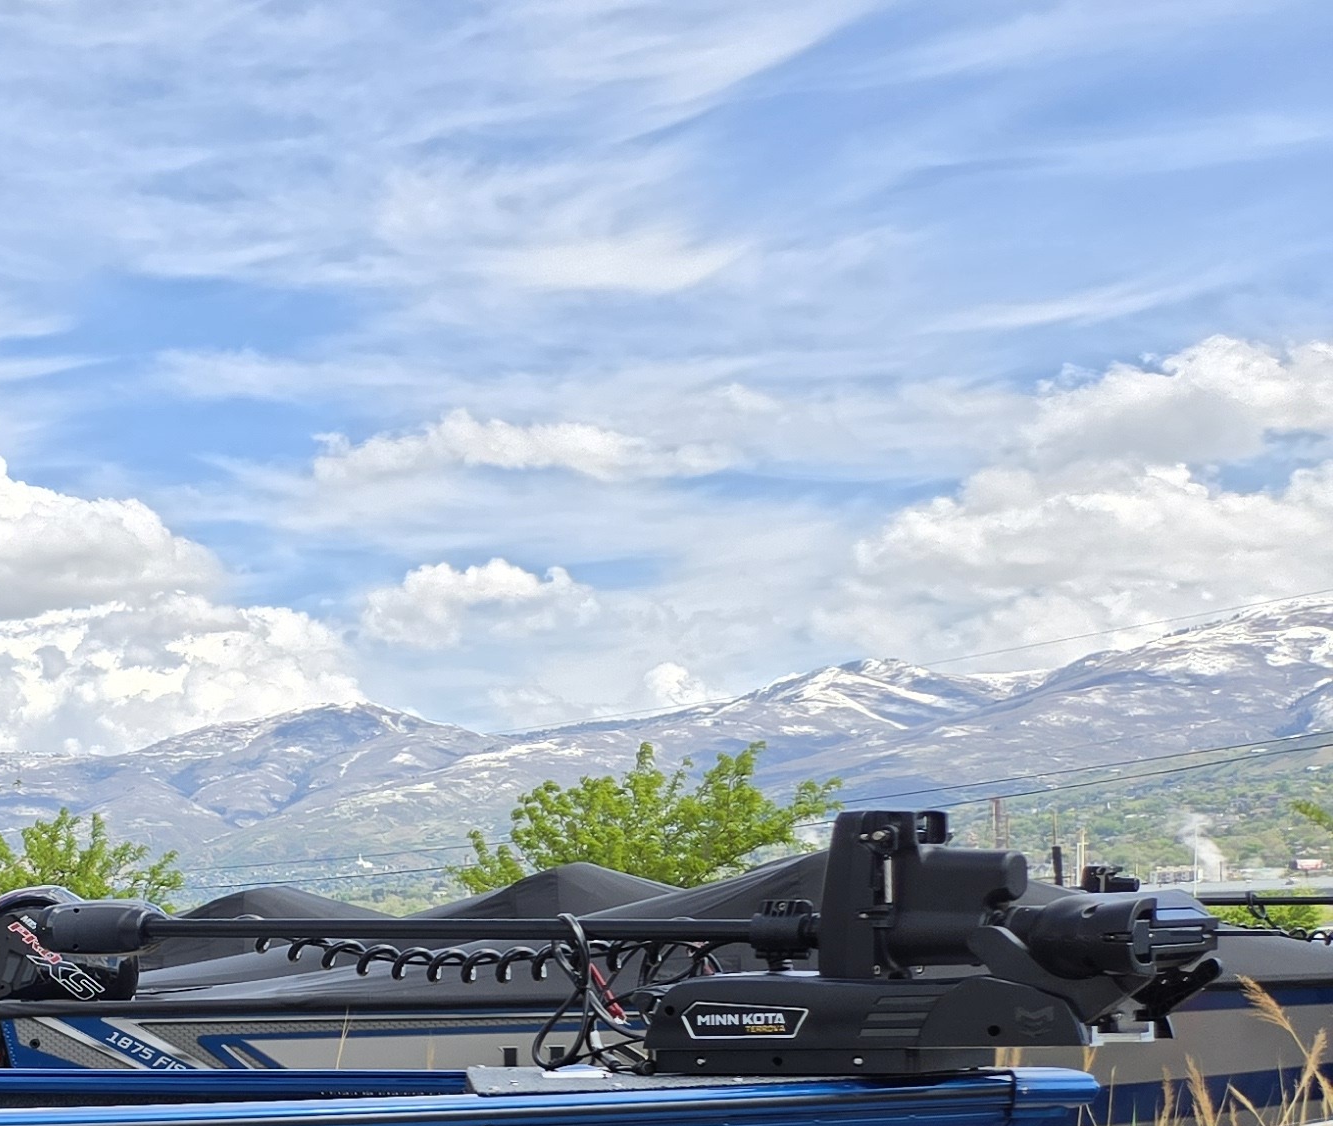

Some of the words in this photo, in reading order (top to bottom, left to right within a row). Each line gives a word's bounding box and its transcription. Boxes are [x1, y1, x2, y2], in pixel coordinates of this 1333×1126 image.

[25, 954, 106, 1001] XS
[696, 1013, 740, 1026] MINN
[742, 1012, 786, 1025] KOTA
[105, 1031, 156, 1060] 1875
